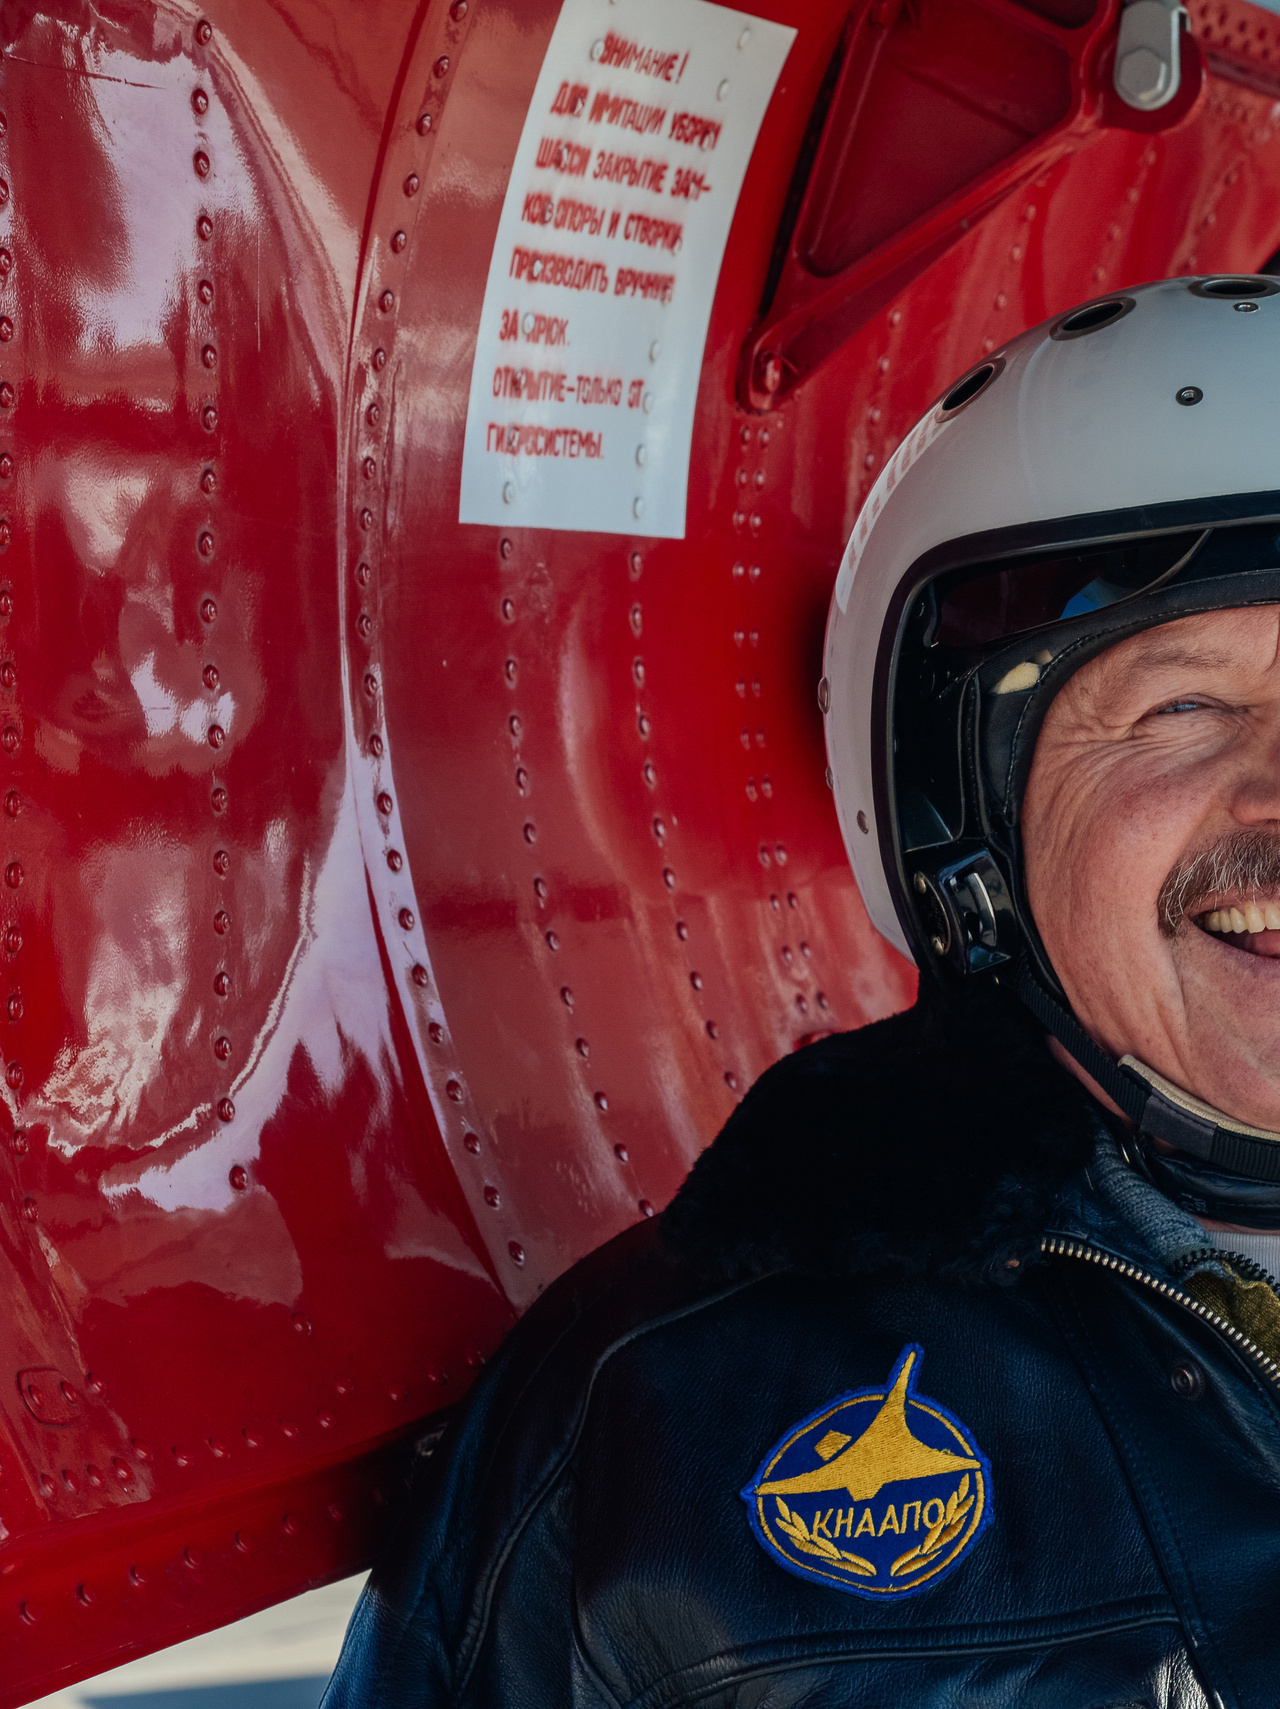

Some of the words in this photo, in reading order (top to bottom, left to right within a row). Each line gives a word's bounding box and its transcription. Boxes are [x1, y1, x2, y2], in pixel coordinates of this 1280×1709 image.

[588, 90, 667, 134] ИМИТАЦИИ
[592, 152, 669, 195] ЗАКРЫТИЕ
[552, 198, 606, 237] ОПОРЫ
[606, 211, 621, 239] И
[499, 308, 520, 342] ЗА
[628, 378, 645, 410] ОТ
[812, 1498, 946, 1538] КНААПО
